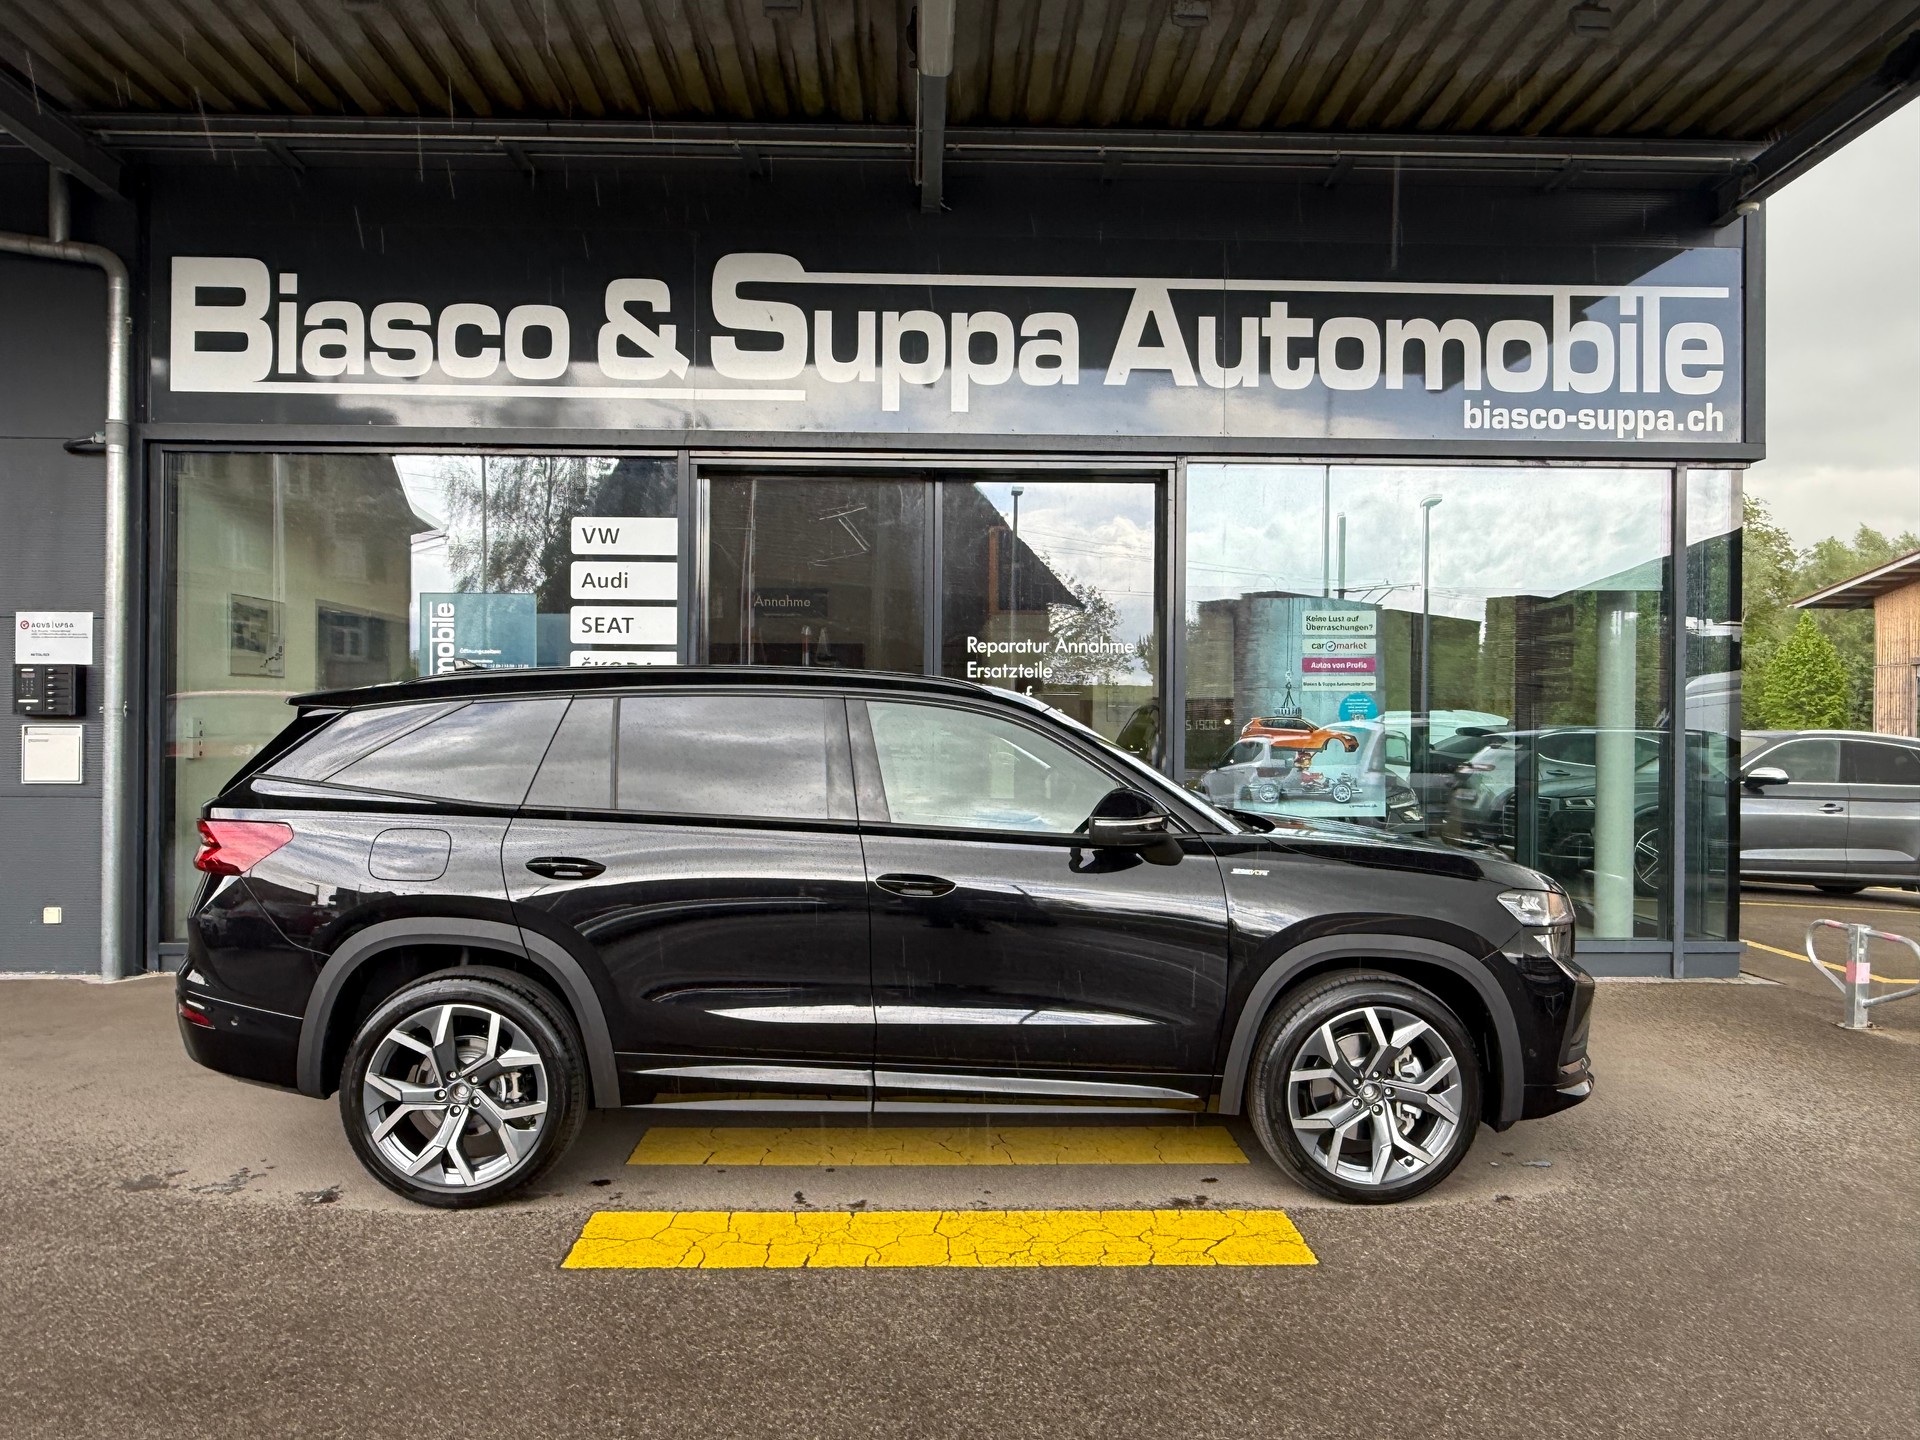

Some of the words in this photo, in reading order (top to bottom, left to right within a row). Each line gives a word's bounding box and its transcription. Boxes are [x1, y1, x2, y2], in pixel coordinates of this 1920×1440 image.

[170, 256, 570, 392] Biasco
[597, 277, 691, 381] &
[710, 251, 1080, 412] Suppa
[1103, 279, 1729, 395] Automobile
[1463, 400, 1723, 439] biasco-suppa.ch
[582, 527, 620, 544] VW
[581, 571, 629, 589] Audi
[753, 594, 811, 607] Annahme
[581, 616, 635, 634] SEAT
[966, 635, 1050, 657] Reparatur
[1054, 635, 1136, 655] Annahme
[966, 661, 1053, 679] Ersatzteile
